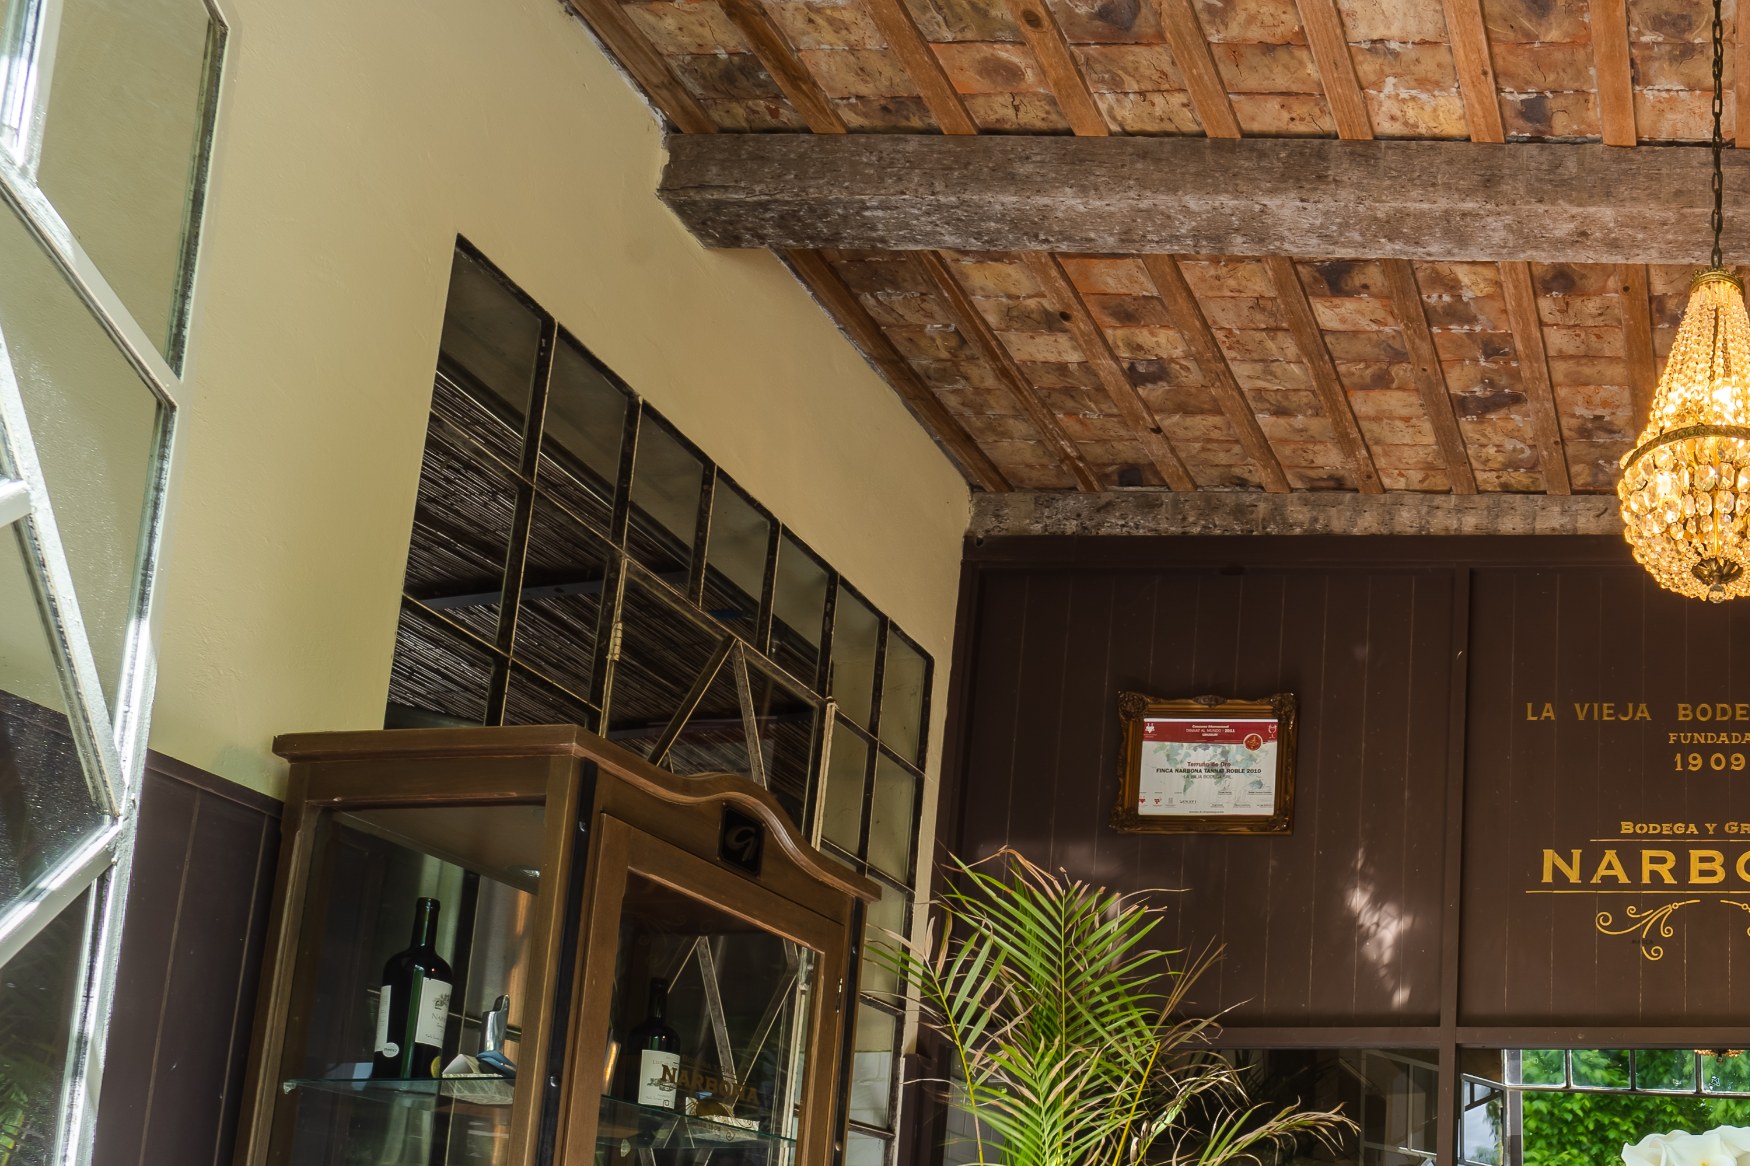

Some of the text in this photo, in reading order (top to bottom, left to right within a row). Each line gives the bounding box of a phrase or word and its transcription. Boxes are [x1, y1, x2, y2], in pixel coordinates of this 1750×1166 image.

[1526, 702, 1556, 721] LA
[1574, 702, 1652, 721] VIEJA
[1673, 752, 1747, 772] 1909
[1705, 823, 1716, 835] Y
[660, 1064, 760, 1103] NARBONA
